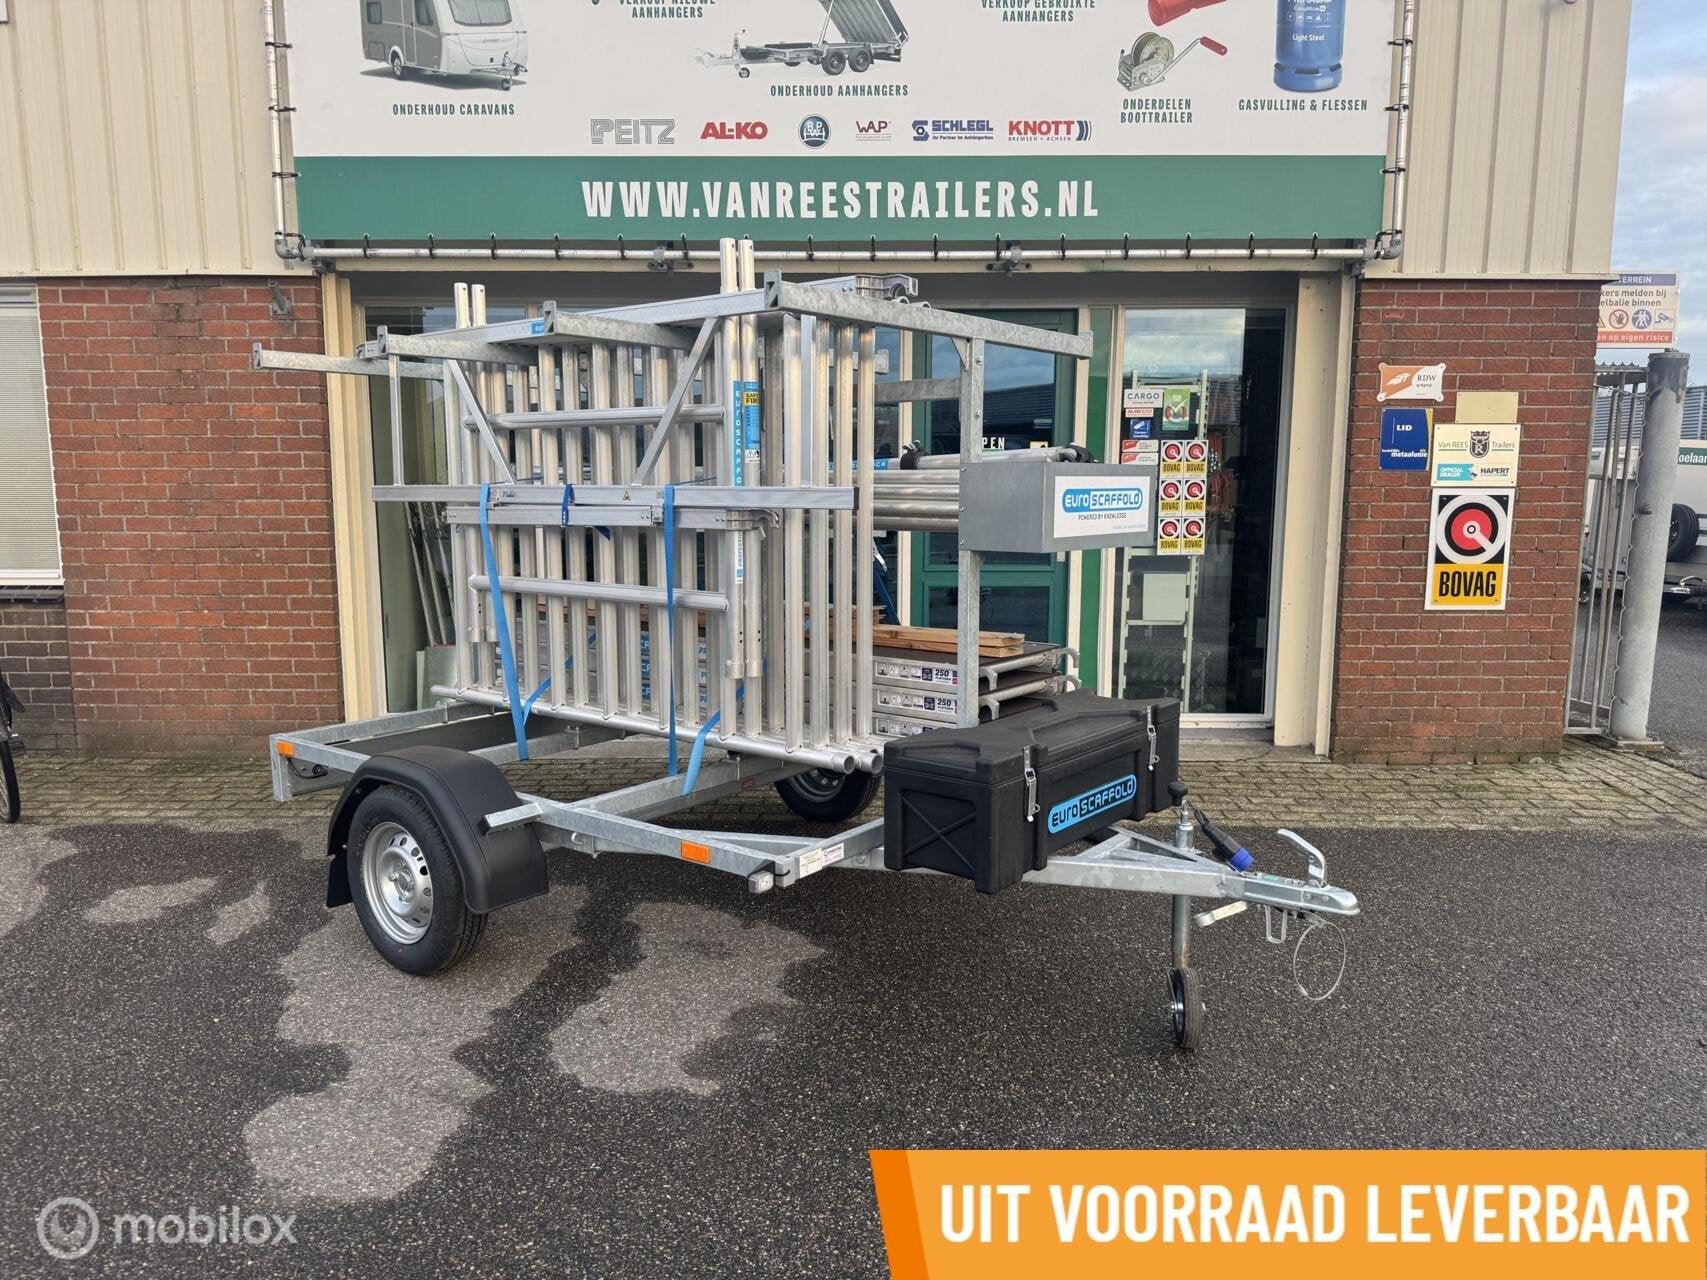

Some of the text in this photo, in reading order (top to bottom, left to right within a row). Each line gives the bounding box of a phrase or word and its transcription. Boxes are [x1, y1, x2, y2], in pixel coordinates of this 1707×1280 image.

[631, 6, 704, 18] AANHANGERS
[1002, 10, 1074, 22] AANHANGERS
[1292, 33, 1307, 42] Light
[770, 84, 908, 97] ONDERHOUD AANHANGERS
[392, 103, 515, 116] ONDERHOUD CARAVANS
[1122, 98, 1192, 110] ONDERDELEN
[1238, 99, 1368, 111] GASVULLING & FLESSEN
[1120, 112, 1193, 124] BOOTTRAILER
[590, 118, 675, 144] PEITZ
[699, 121, 768, 140] AL-KO
[932, 119, 994, 132] SCHLEGL
[1008, 120, 1075, 136] KNOTT
[581, 180, 1099, 218] WWW.VANREESTRAILERS.NL
[1600, 289, 1667, 299] kers melden bij
[1600, 299, 1661, 307] elbalie binnen
[1621, 333, 1644, 342] eigen
[1646, 333, 1669, 341] risico
[1417, 374, 1437, 382] RDW
[1127, 392, 1160, 400] CARGO
[982, 436, 1005, 449] PEN
[1438, 570, 1497, 597] BOVAG
[935, 669, 949, 677] 250
[937, 698, 952, 706] 250
